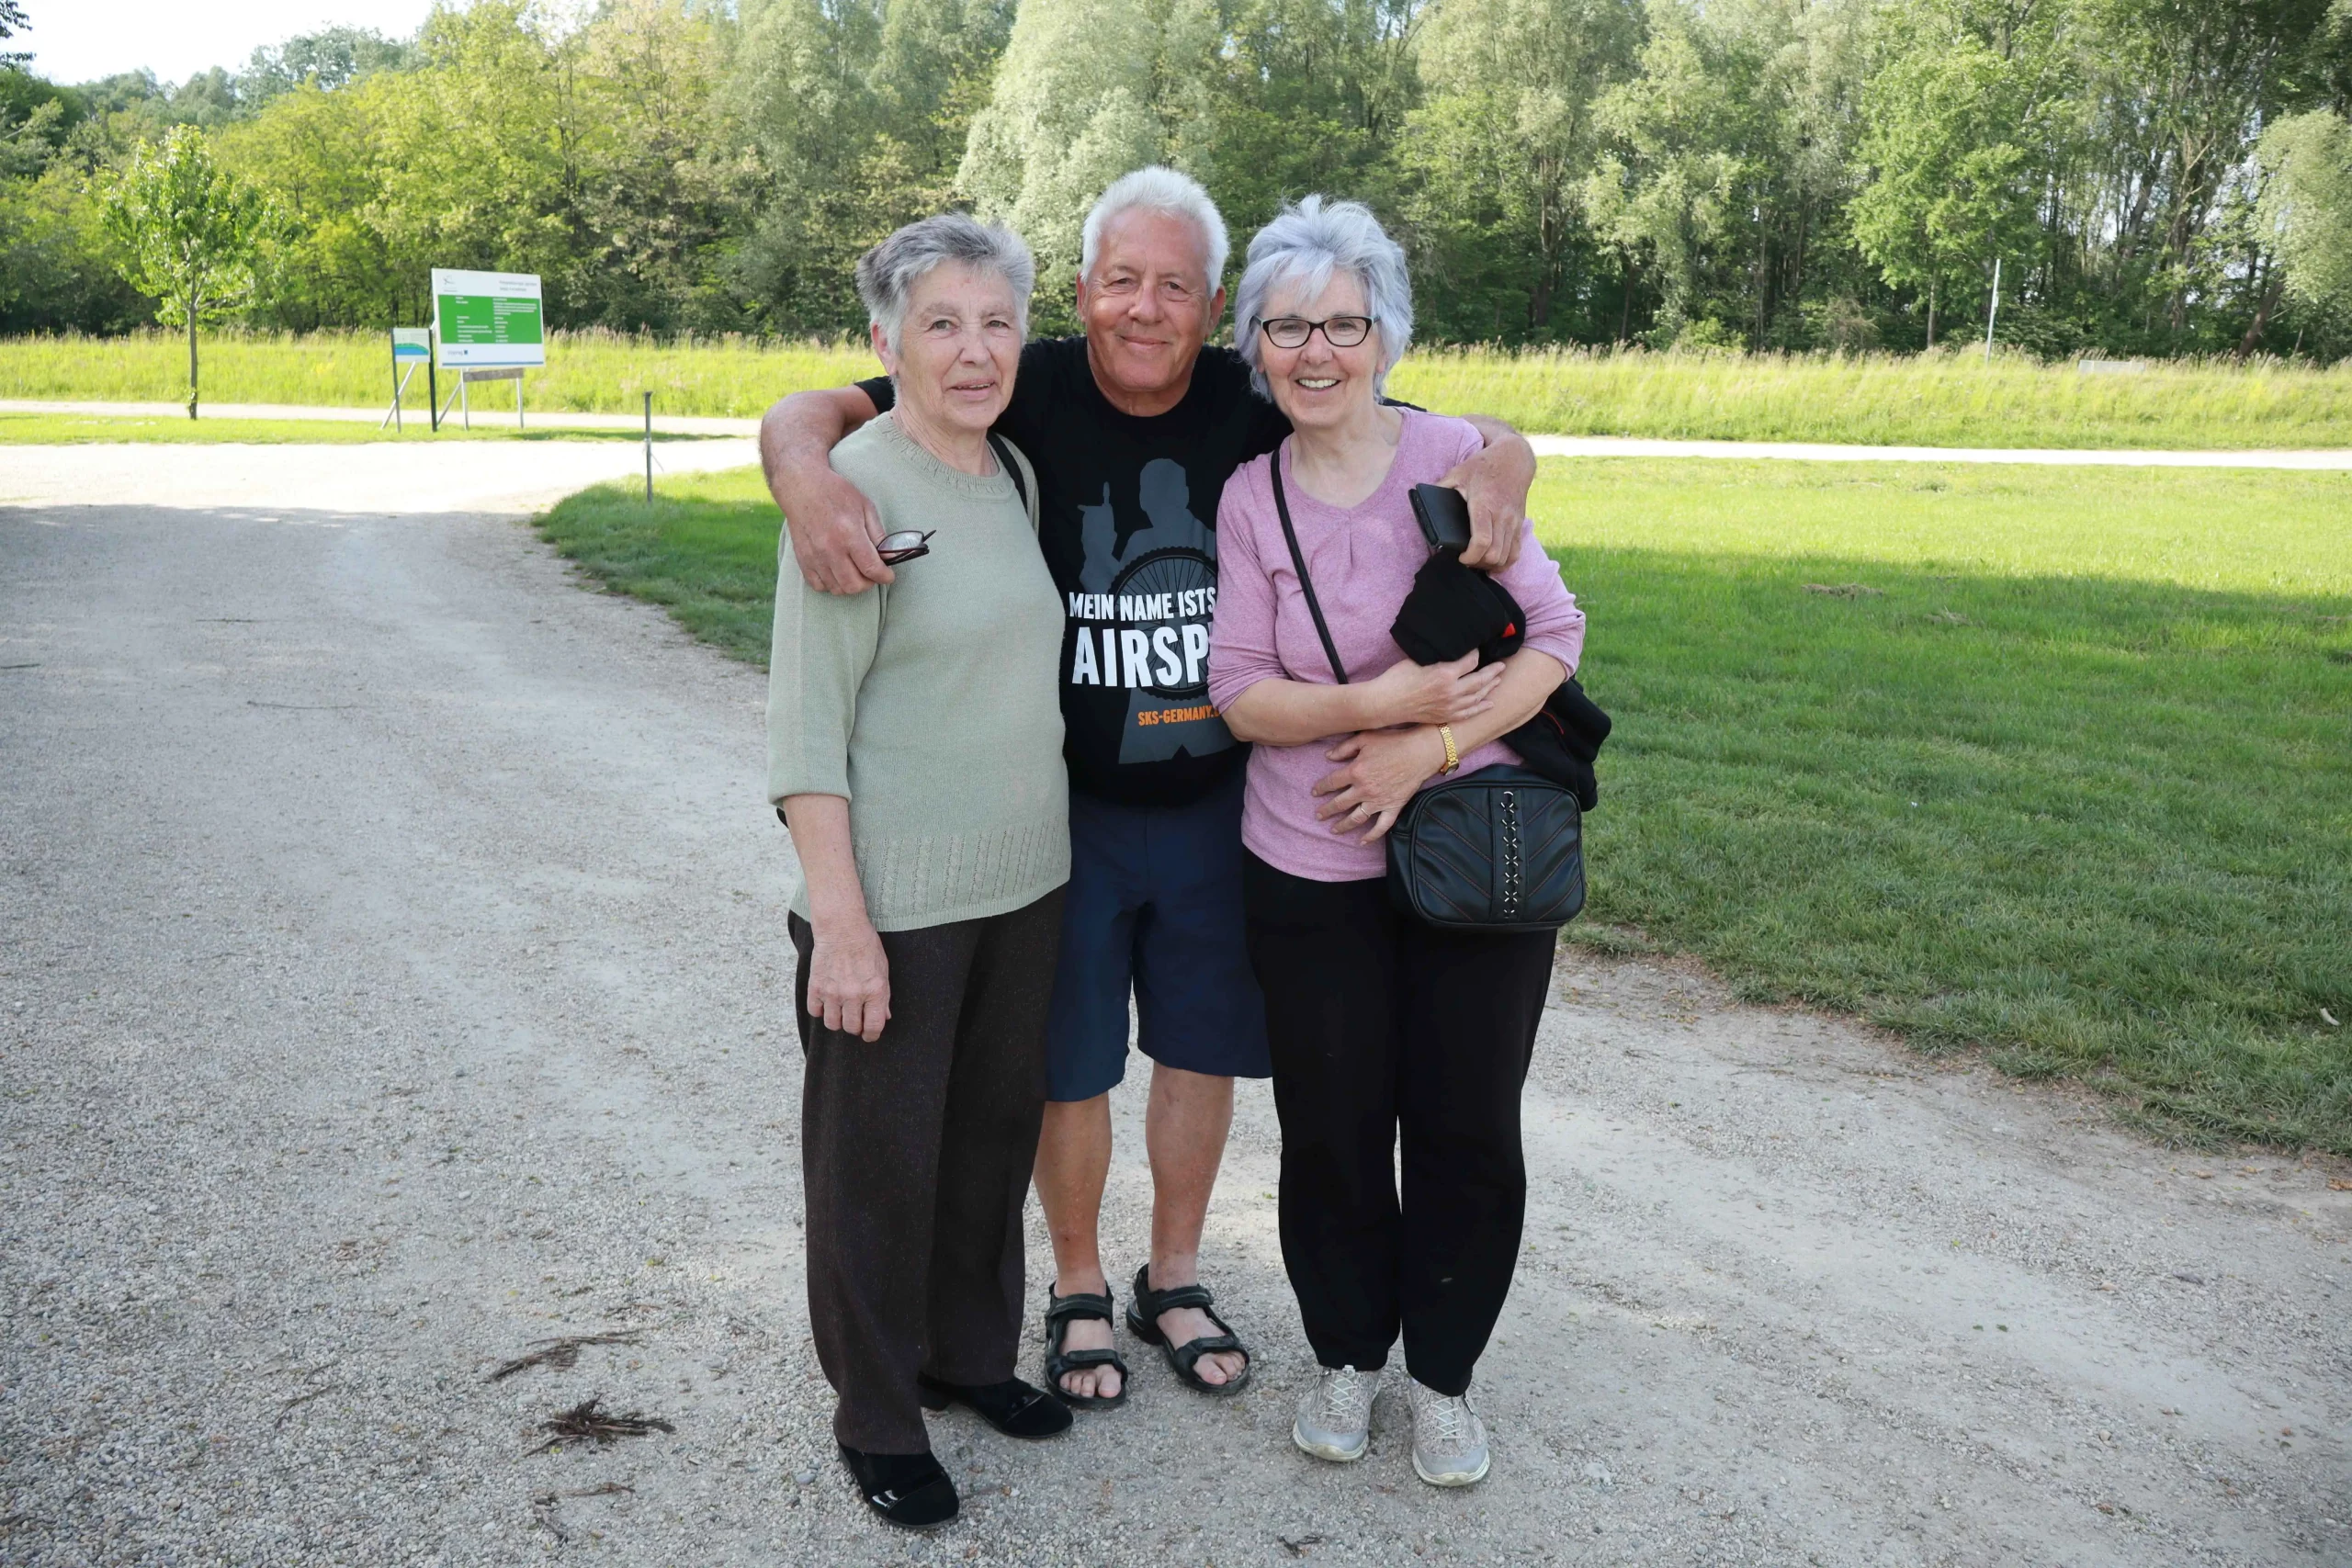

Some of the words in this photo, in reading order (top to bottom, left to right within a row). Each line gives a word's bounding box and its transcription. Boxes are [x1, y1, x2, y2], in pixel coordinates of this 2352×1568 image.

[1069, 592, 1114, 620] MEIN
[1119, 592, 1174, 621] NAME
[1071, 622, 1215, 688] AIRSP
